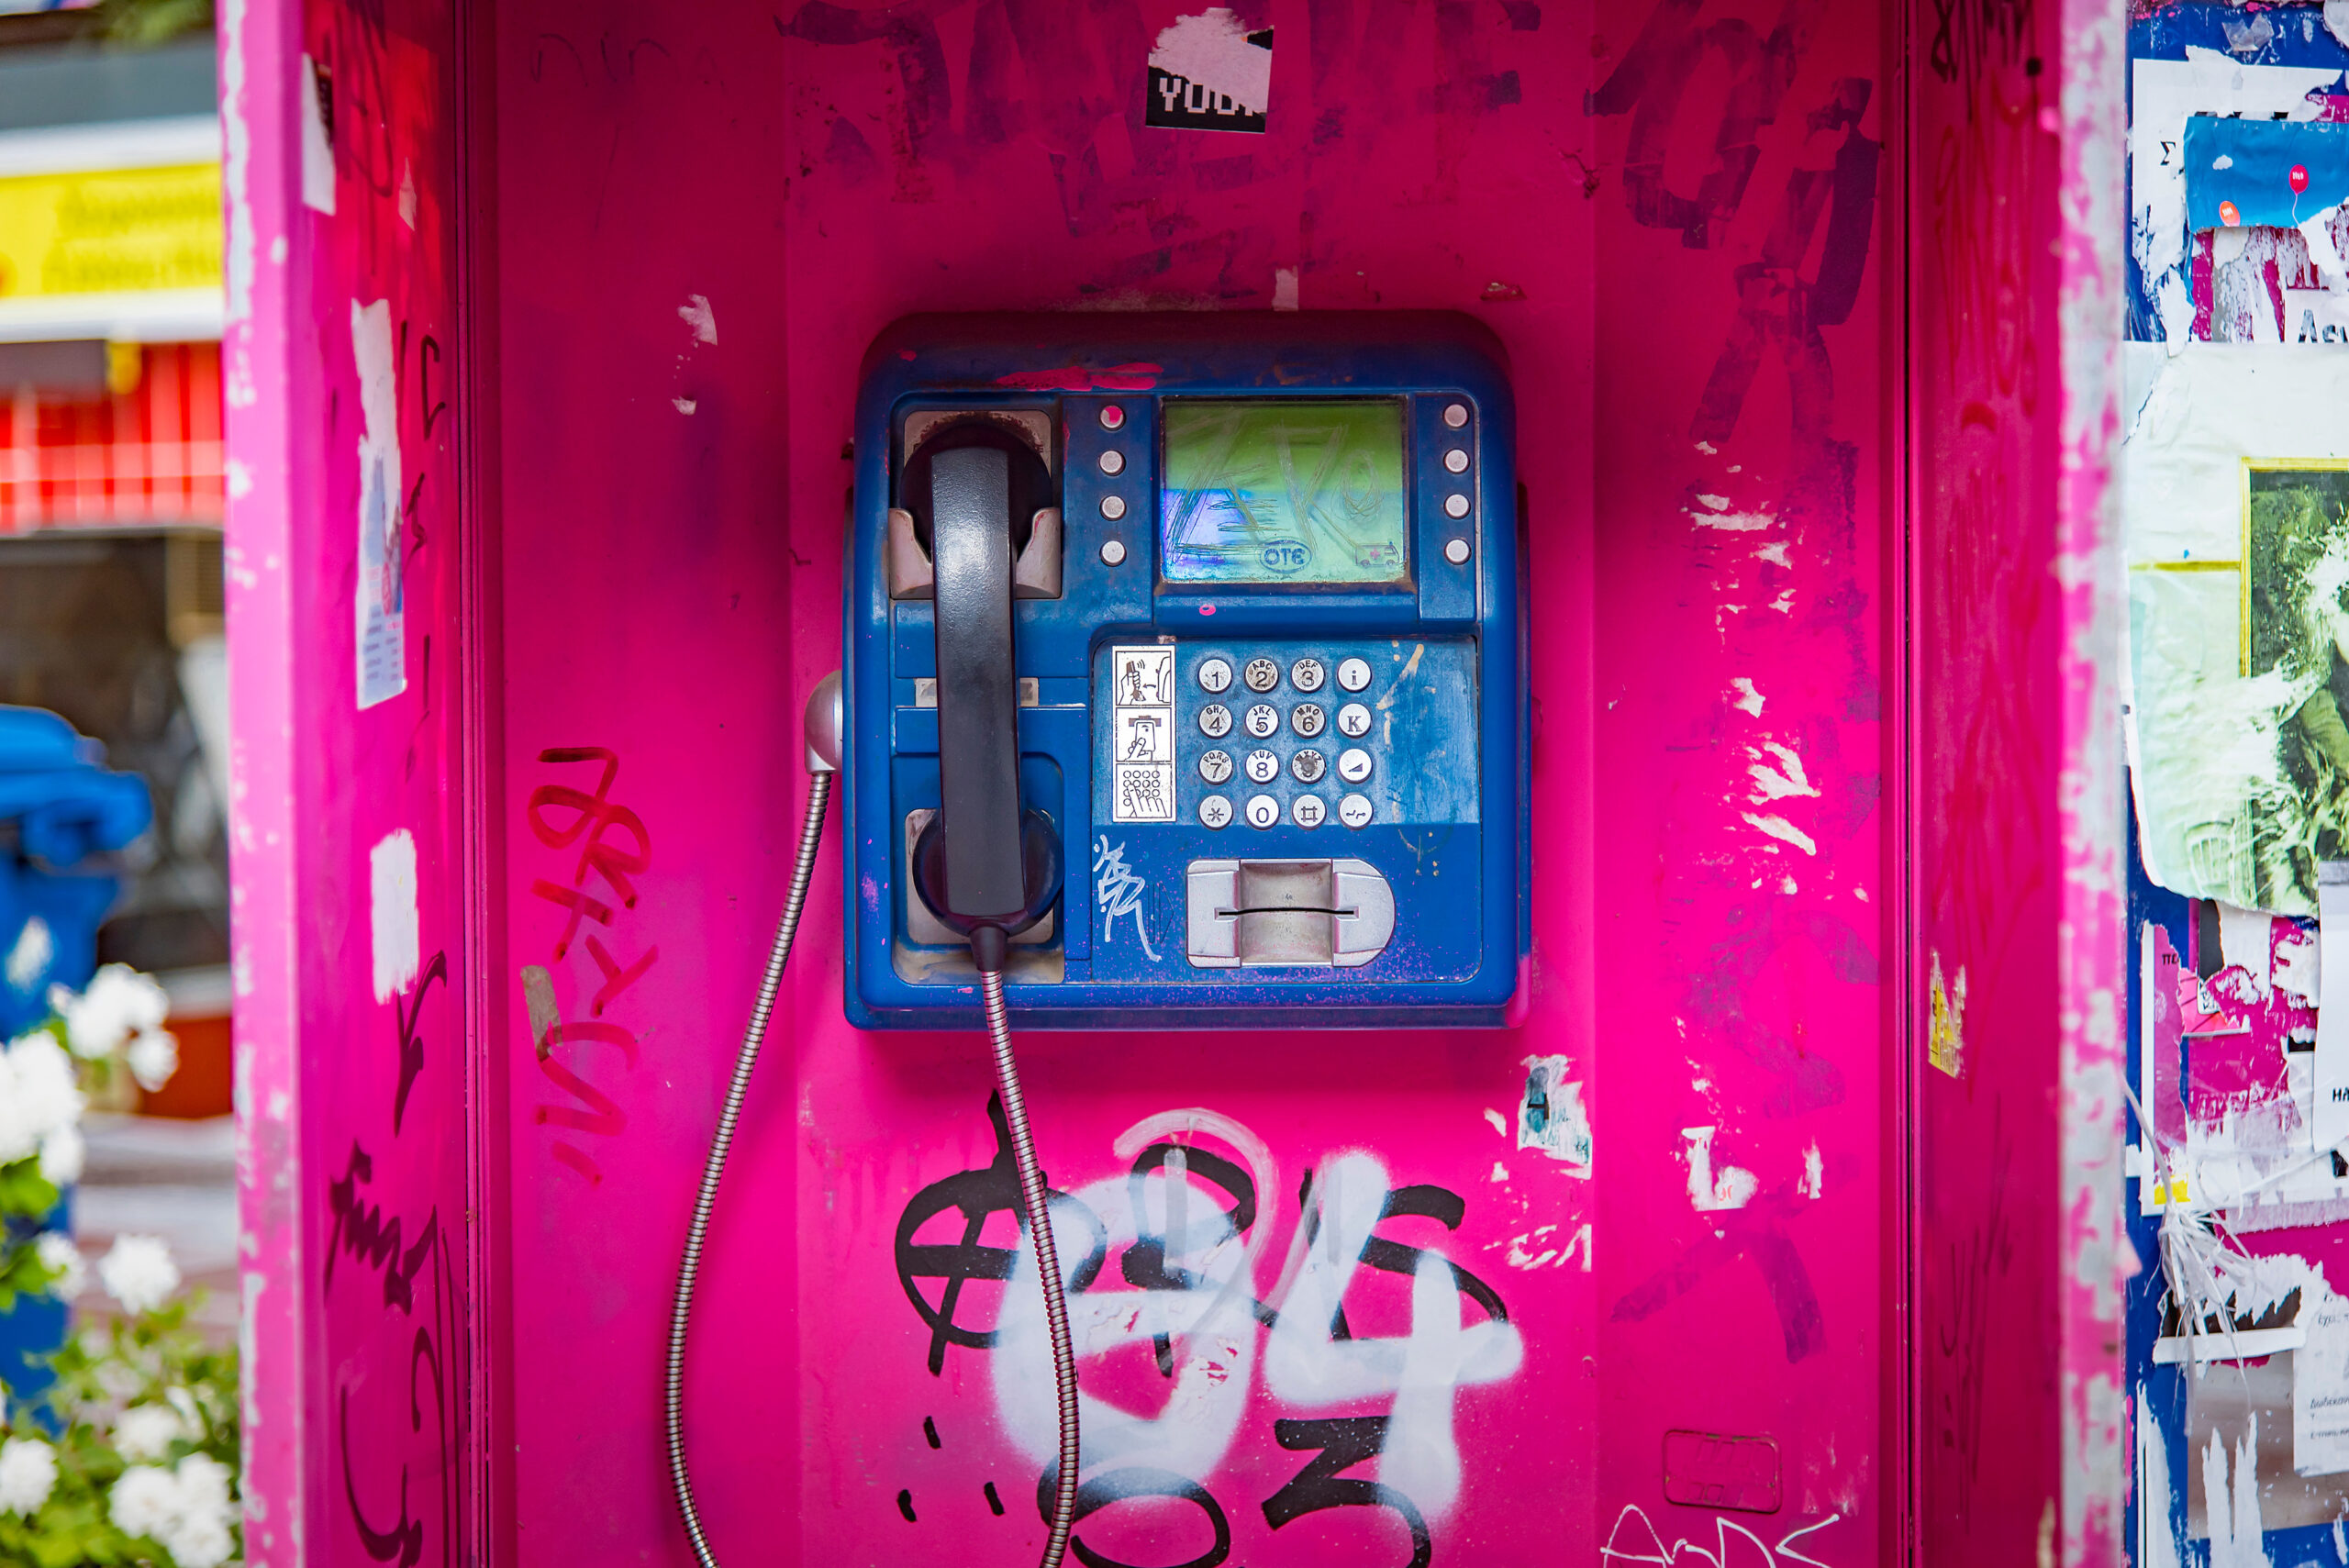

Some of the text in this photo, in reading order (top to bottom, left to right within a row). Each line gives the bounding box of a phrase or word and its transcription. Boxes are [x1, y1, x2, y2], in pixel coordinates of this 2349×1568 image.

[1252, 660, 1319, 671] ABC DEF
[1211, 670, 1358, 688] 1 2 3 i
[1206, 705, 1319, 717] GHI JKL MNO
[1208, 716, 1364, 733] 4 5 6 K
[1202, 751, 1230, 763] PQRS
[1252, 751, 1274, 761] TUV
[1209, 762, 1269, 779] 7 8
